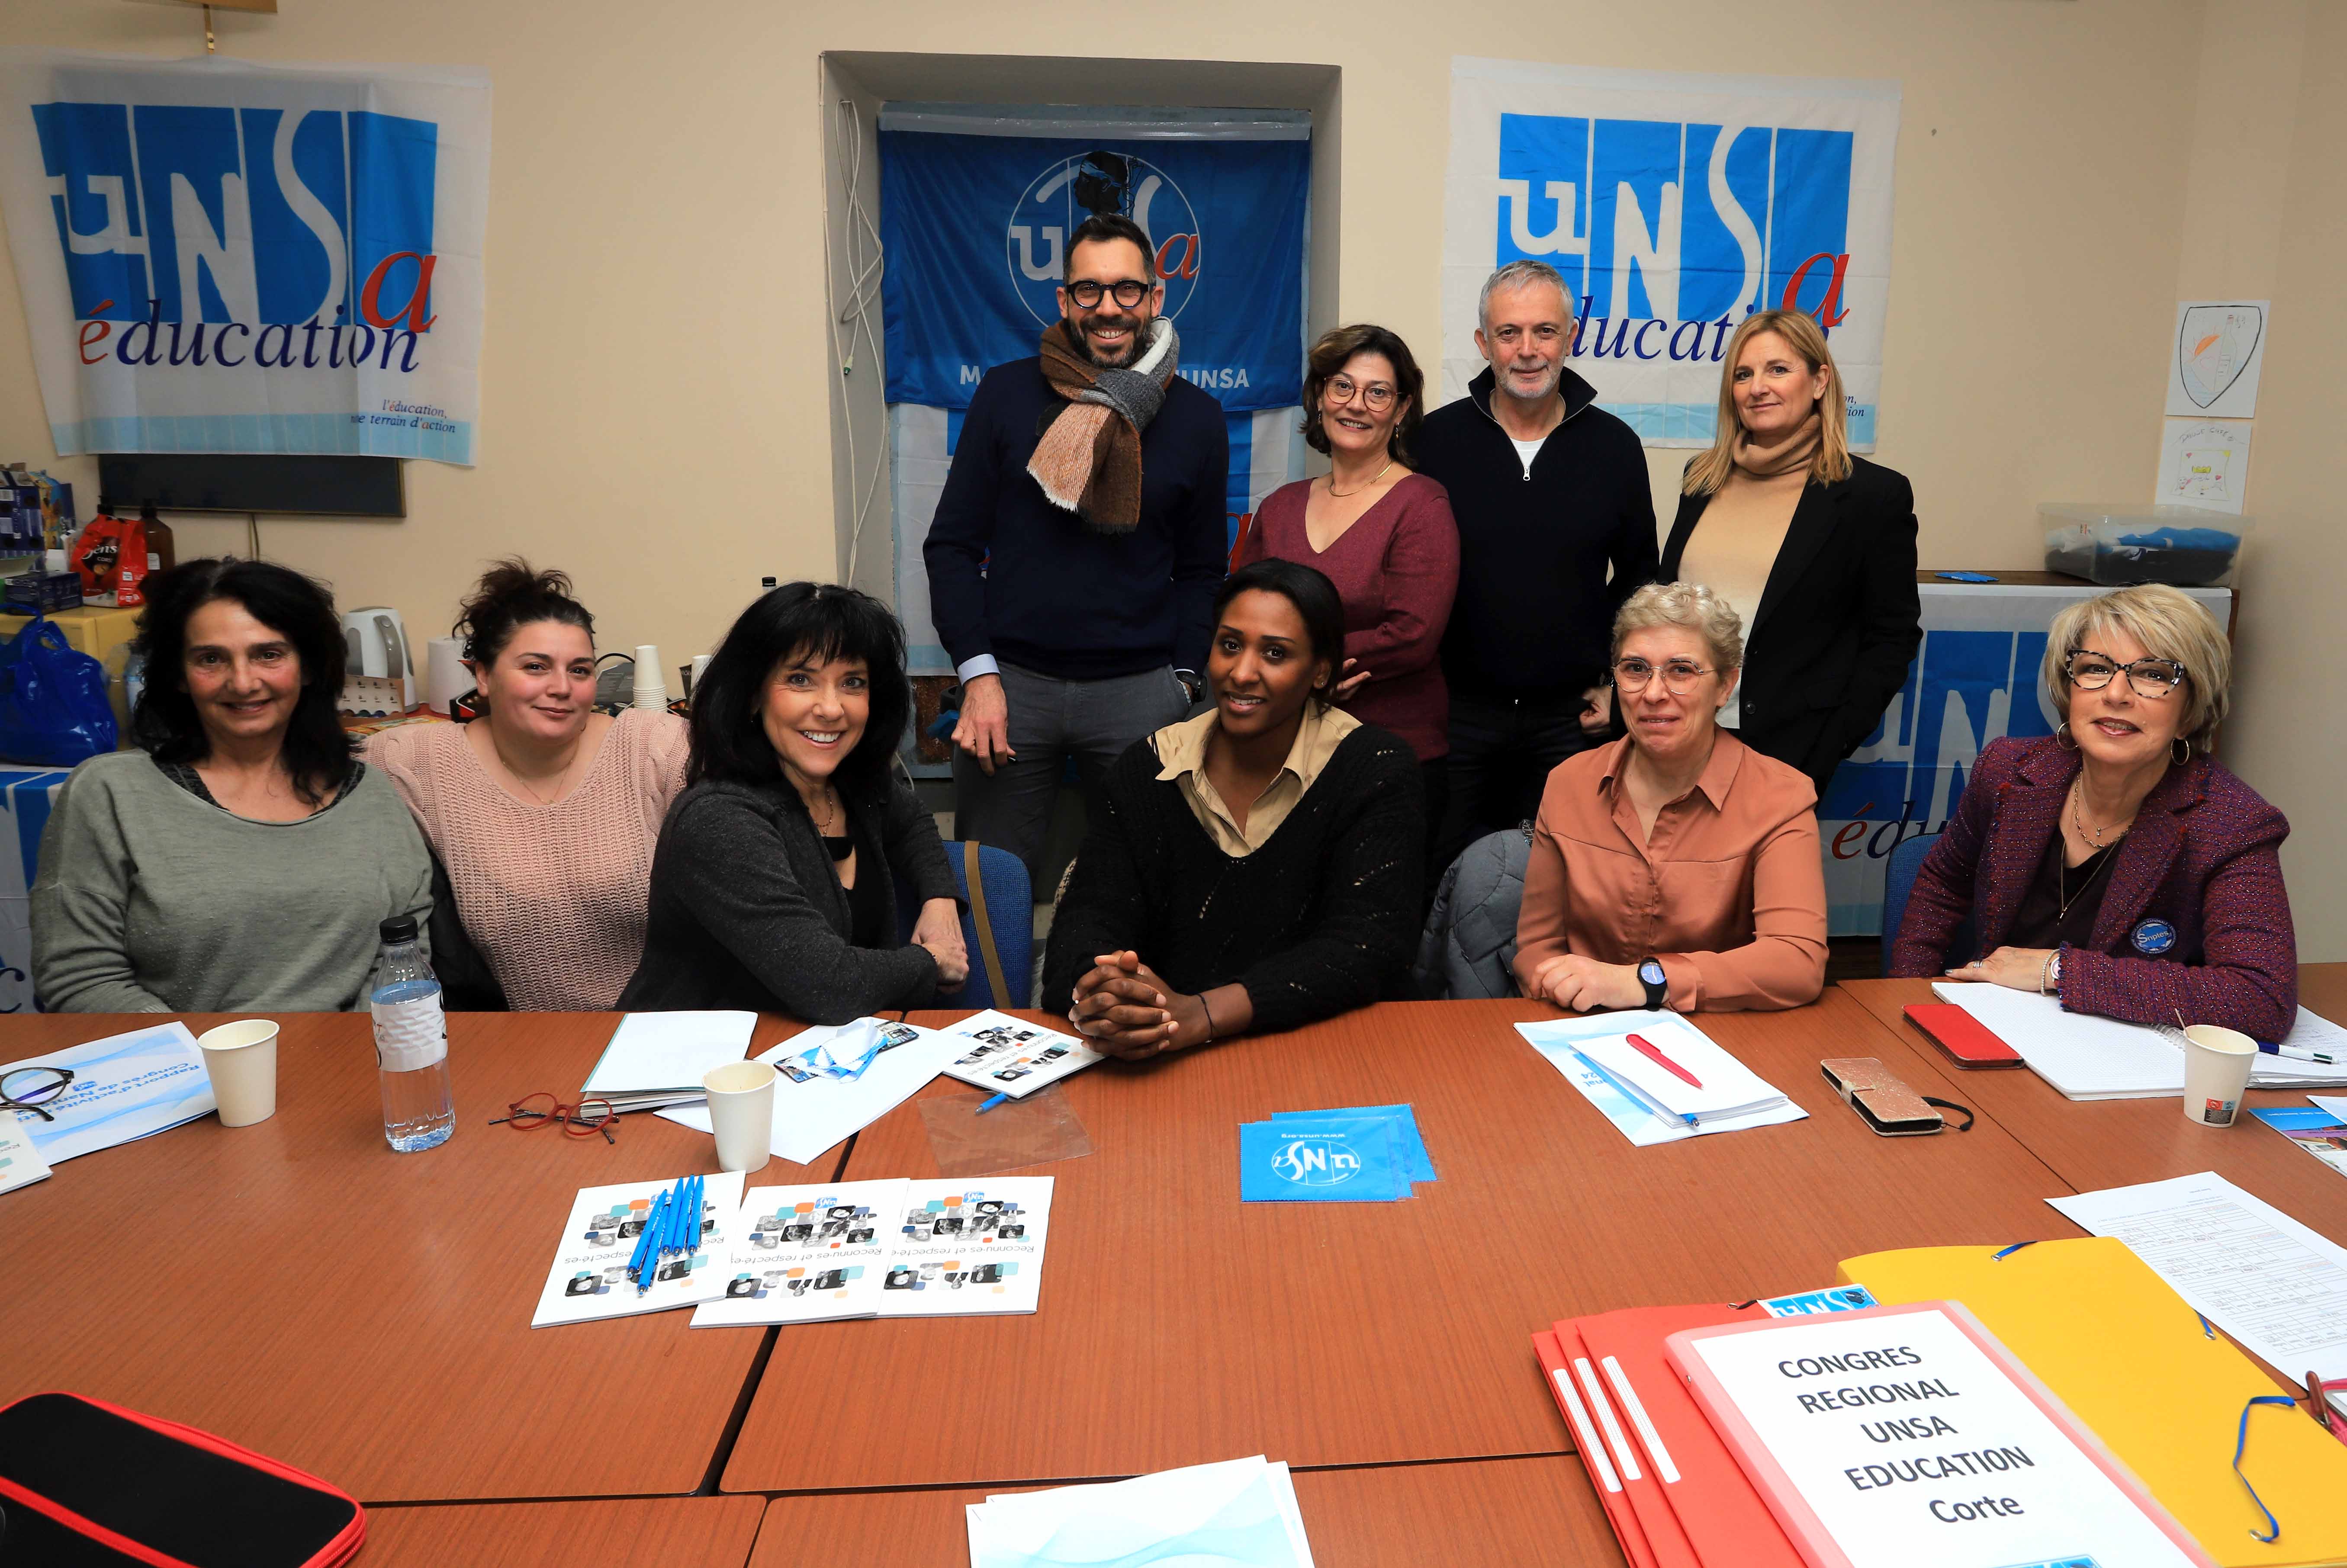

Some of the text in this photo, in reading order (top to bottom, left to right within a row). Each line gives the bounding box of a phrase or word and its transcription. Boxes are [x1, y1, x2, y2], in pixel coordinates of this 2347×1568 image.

[79, 299, 419, 372] éducation
[382, 399, 447, 419] l'éducation,
[370, 415, 406, 426] terrain
[410, 417, 456, 433] d'action
[2137, 931, 2169, 944] Snptes
[122, 1063, 189, 1084] Congrès
[135, 1065, 199, 1089] Rapport
[99, 1083, 119, 1092] de
[54, 1086, 131, 1112] d'activité
[564, 1250, 632, 1264] especté·es
[801, 1254, 812, 1263] et
[891, 1248, 951, 1256] respecté·e
[1778, 1346, 1922, 1378] CONGRES
[1797, 1378, 1960, 1414] REGIONAL
[1860, 1416, 1959, 1443] UNSA
[1844, 1446, 2035, 1491] EDUCATION
[1929, 1496, 2025, 1523] Corte
